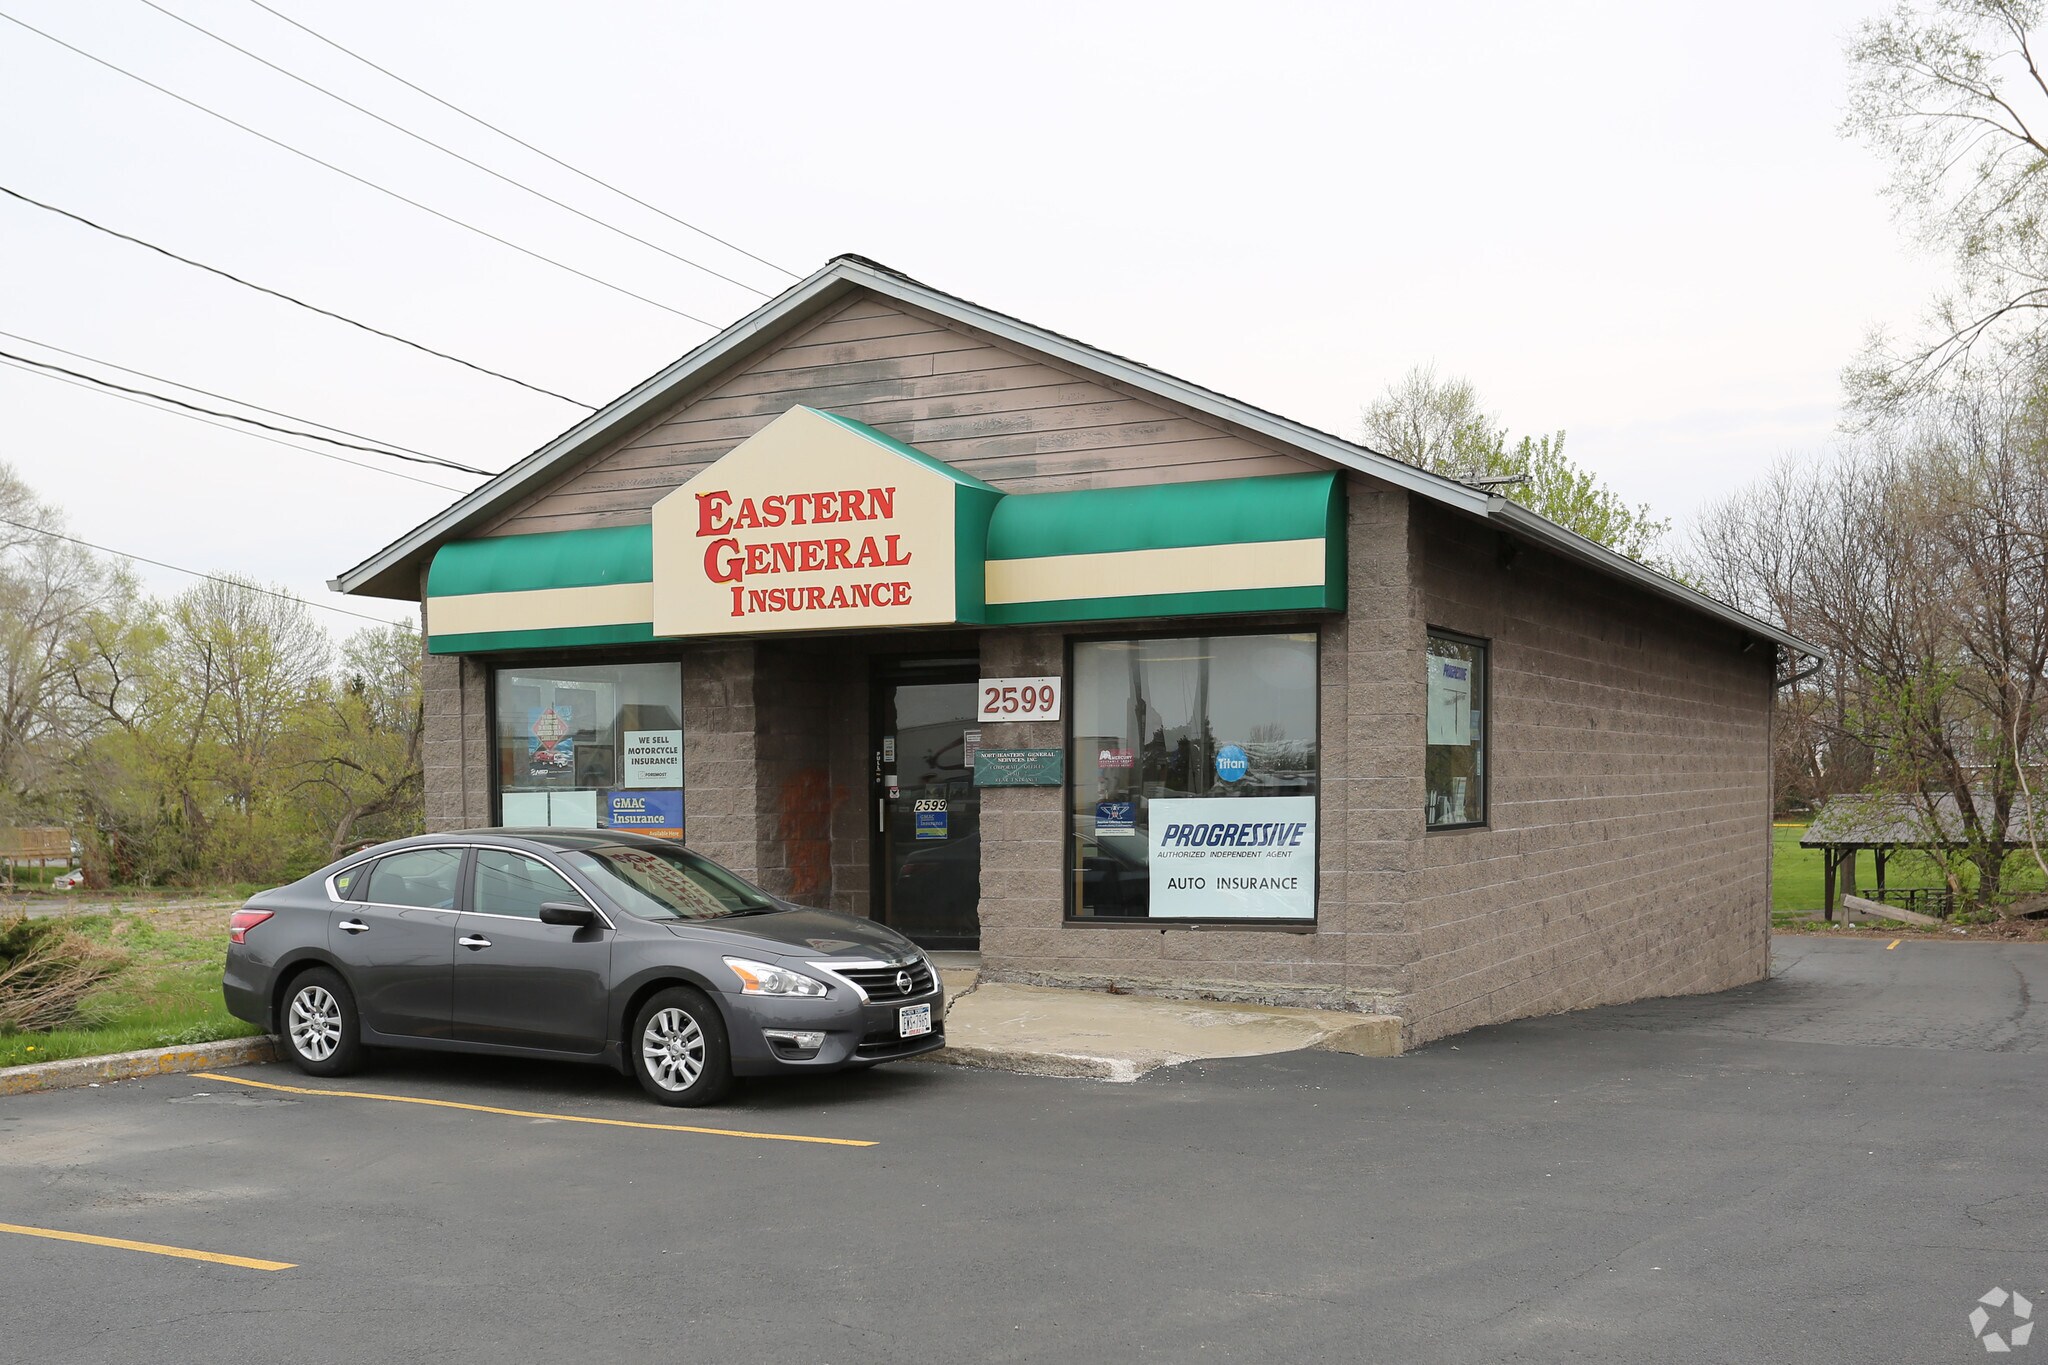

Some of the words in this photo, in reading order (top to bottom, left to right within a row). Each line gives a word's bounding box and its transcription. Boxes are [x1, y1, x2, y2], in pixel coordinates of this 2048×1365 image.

[695, 486, 896, 537] EASTERN
[703, 534, 912, 583] GENERAL
[730, 581, 912, 617] INSURANCE
[983, 685, 1054, 713] 2599
[652, 736, 669, 744] SELL
[627, 747, 678, 755] MOTORCYCLE
[631, 757, 678, 765] INSURANCE!
[1218, 758, 1245, 769] Titan
[612, 798, 646, 809] GMAC
[915, 800, 946, 811] 2599
[612, 813, 665, 824] Insurance
[1161, 823, 1307, 847] PROGRESSIVE
[1266, 850, 1293, 858] AGENT
[1167, 878, 1206, 890] AUTO
[1216, 877, 1298, 890] INSURANCE
